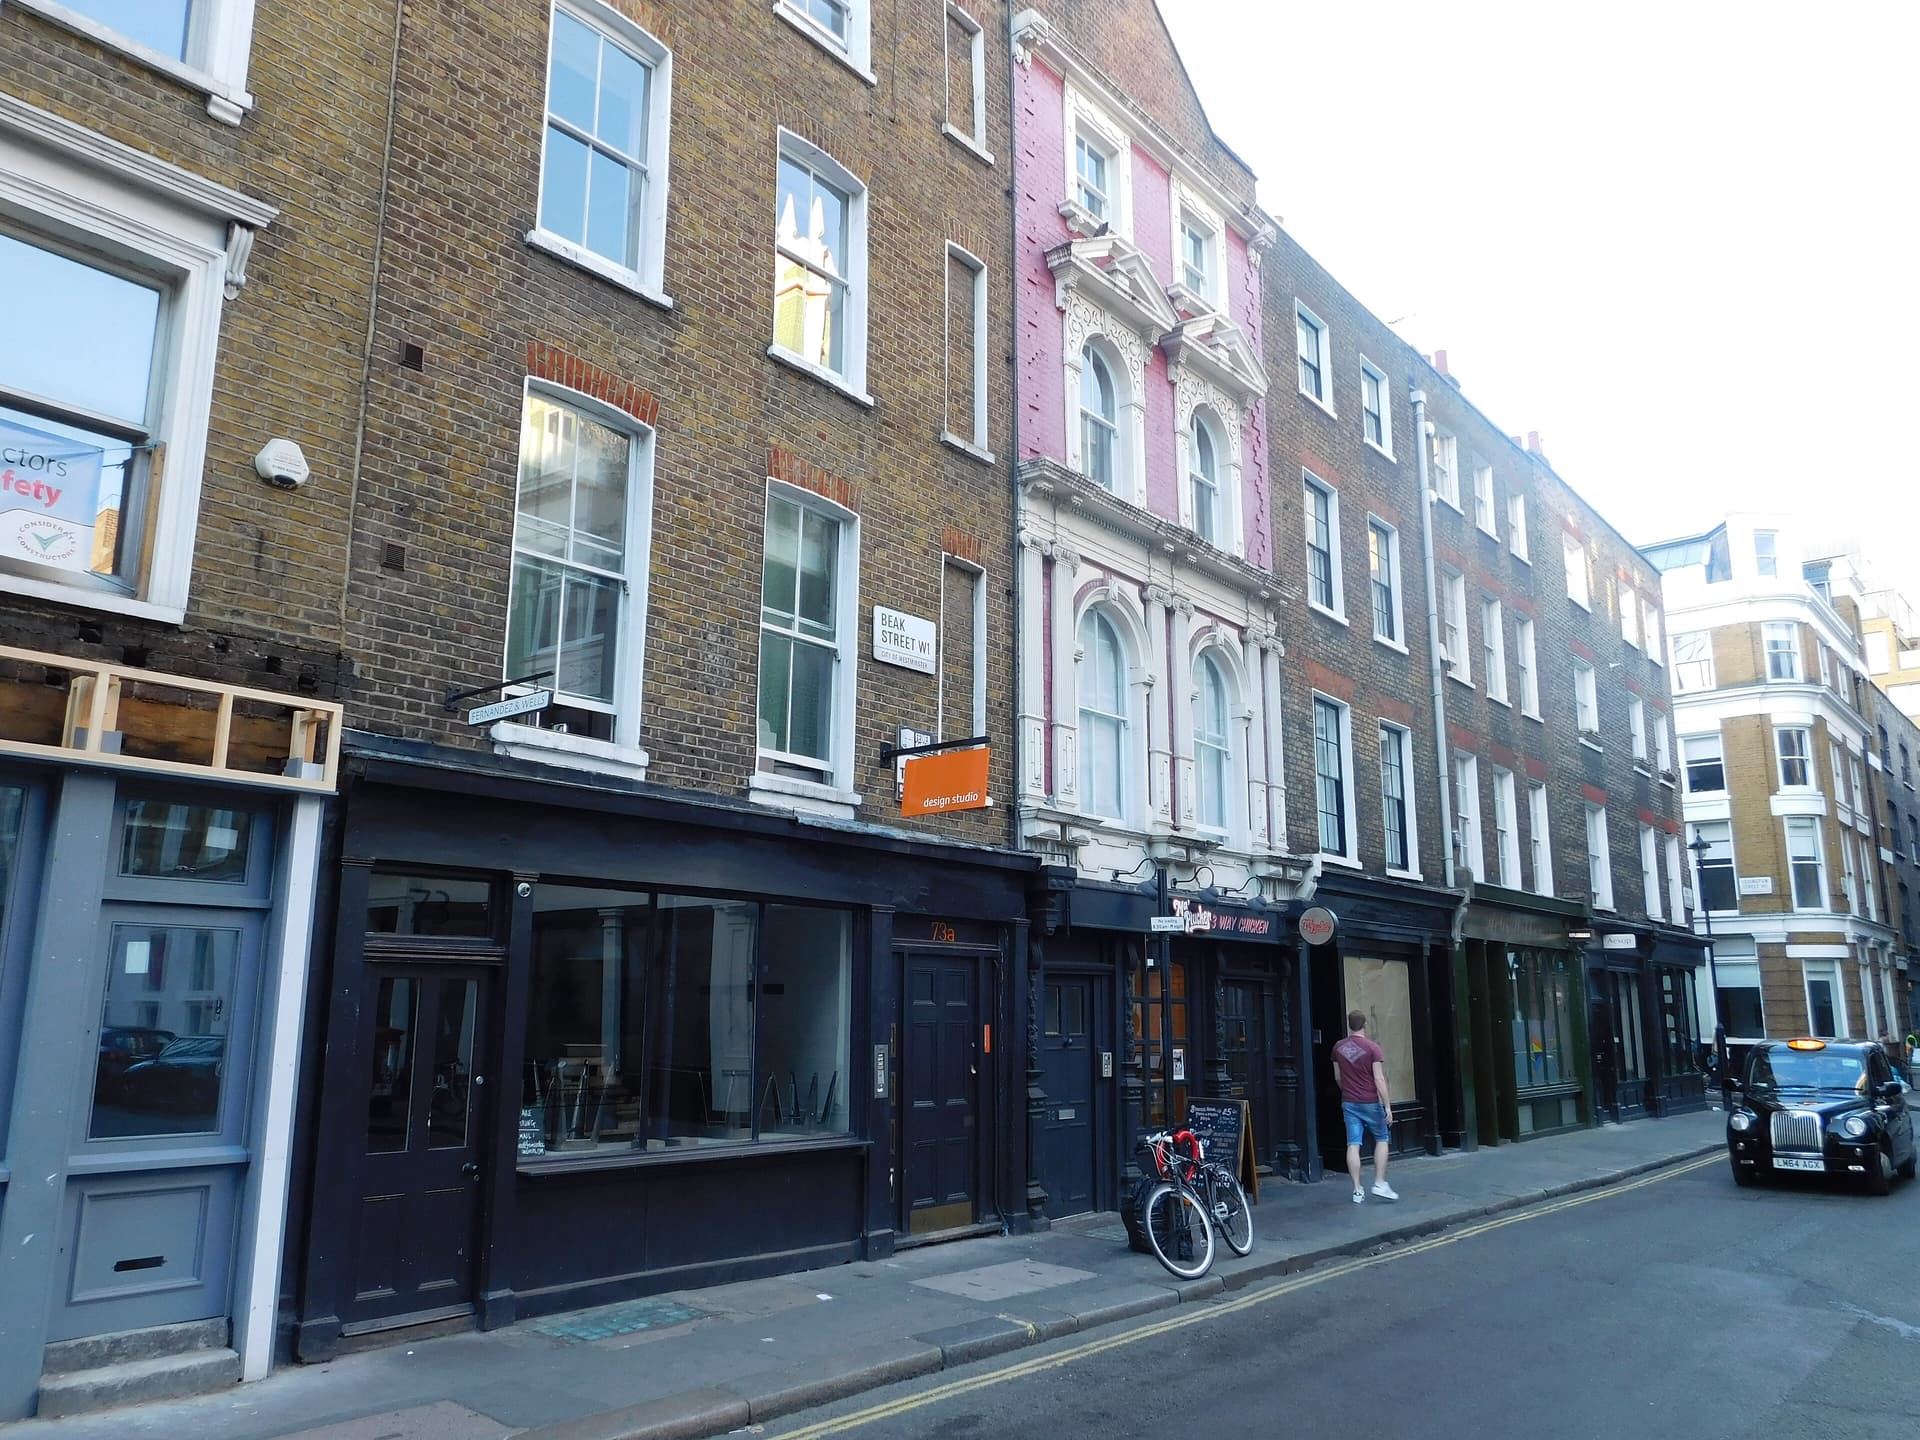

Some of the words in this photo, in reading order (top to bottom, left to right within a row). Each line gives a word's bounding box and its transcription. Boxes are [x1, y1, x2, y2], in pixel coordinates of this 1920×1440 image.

[2, 447, 67, 477] ctors
[1, 469, 63, 508] fety
[881, 613, 906, 632] BEAK
[881, 630, 916, 651] STREET
[918, 640, 930, 656] W1
[898, 655, 928, 669] WESTMINSTER
[471, 704, 513, 721] FERNANDEZ
[515, 701, 520, 711] &
[522, 695, 546, 709] WELLS
[923, 795, 951, 808] design
[952, 791, 979, 804] studio
[931, 921, 956, 943] 73a
[1211, 915, 1217, 929] 3
[1219, 915, 1237, 931] WAY
[1238, 918, 1270, 935] CHICKEN
[1607, 936, 1632, 945] Aesop
